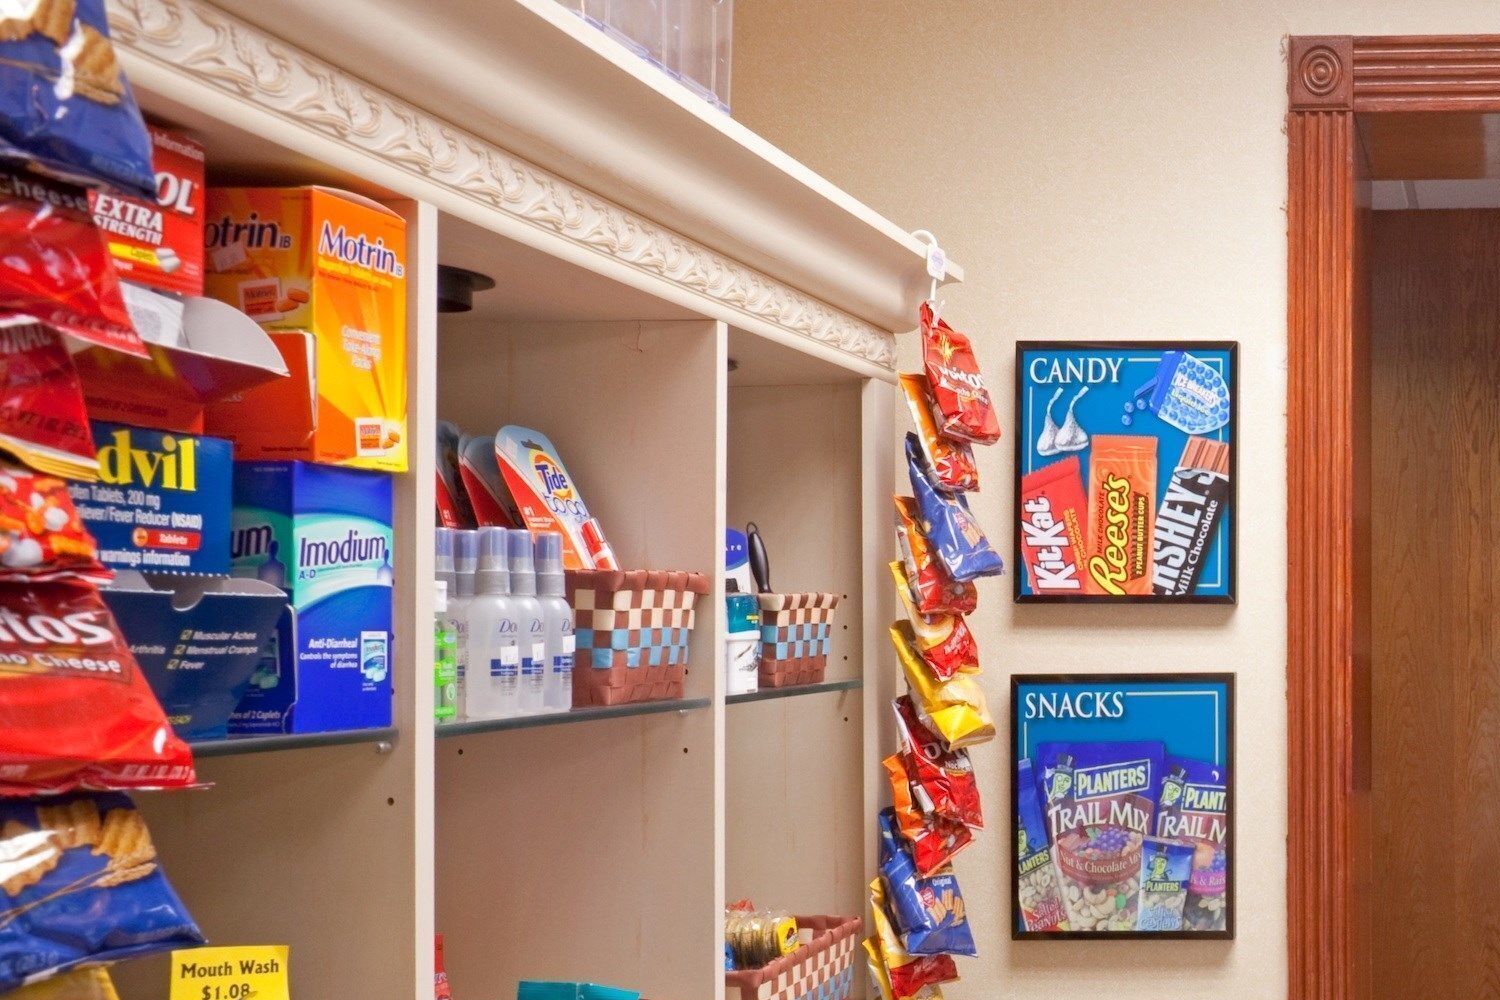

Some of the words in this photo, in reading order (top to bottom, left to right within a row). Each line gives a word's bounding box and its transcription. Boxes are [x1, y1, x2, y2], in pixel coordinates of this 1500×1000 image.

[94, 193, 163, 232] EXTRA
[319, 220, 395, 274] Motrin
[1029, 356, 1124, 385] CANDY
[534, 463, 569, 495] Tide
[128, 489, 145, 504] 200
[146, 494, 161, 510] mg
[1097, 492, 1106, 533] CHOCOLATE
[1138, 496, 1146, 517] CUPS
[135, 511, 170, 526] Reducer
[1021, 496, 1070, 546] Kat
[1137, 517, 1145, 543] BUTTER
[1188, 499, 1219, 565] Chocolate
[1088, 472, 1131, 595] Reese's
[101, 549, 142, 567] warnings
[142, 550, 191, 567] information
[299, 529, 386, 568] Imodium
[1136, 543, 1144, 568] PEANUT
[1032, 546, 1081, 589] Kit
[192, 631, 231, 641] Muscular
[232, 631, 257, 641] Aches
[308, 638, 357, 649] Anti-Diarrheal
[32, 653, 122, 674] Cheese
[179, 660, 205, 670] Fever
[1024, 691, 1124, 719] SNACKS
[1077, 766, 1146, 795] PLANTERS
[1048, 800, 1107, 838] TRAIL
[1107, 800, 1150, 836] MIX
[1085, 860, 1127, 874] Chocolate
[1146, 881, 1179, 893] PLANTERS
[180, 961, 233, 978] Mouth
[239, 959, 280, 976] Wash
